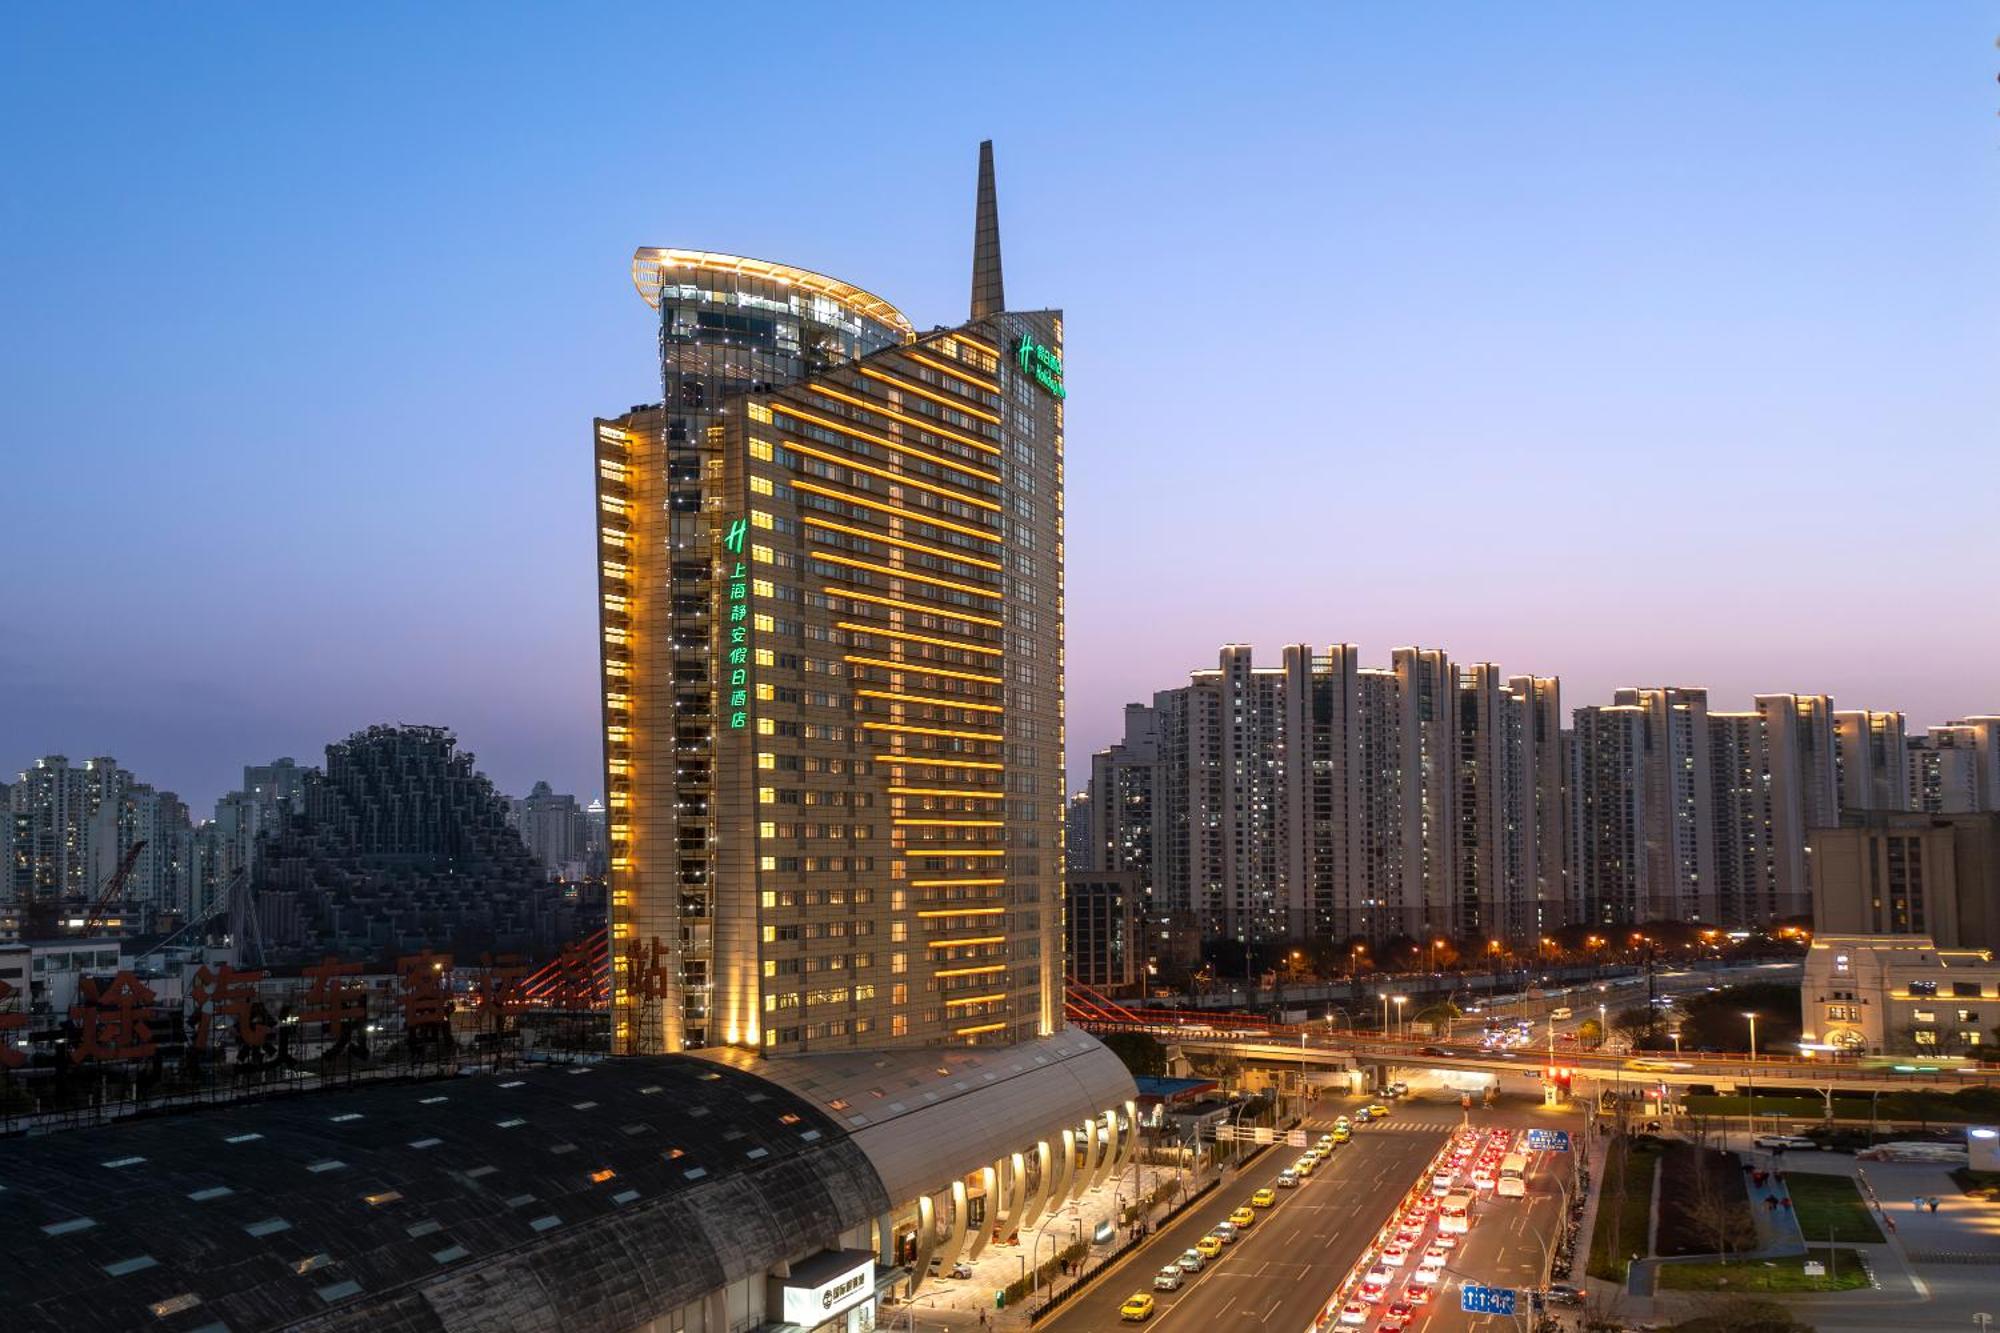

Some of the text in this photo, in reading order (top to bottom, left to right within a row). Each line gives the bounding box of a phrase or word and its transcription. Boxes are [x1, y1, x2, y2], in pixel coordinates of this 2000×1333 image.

[729, 562, 747, 729] 上海静安假日酒店
